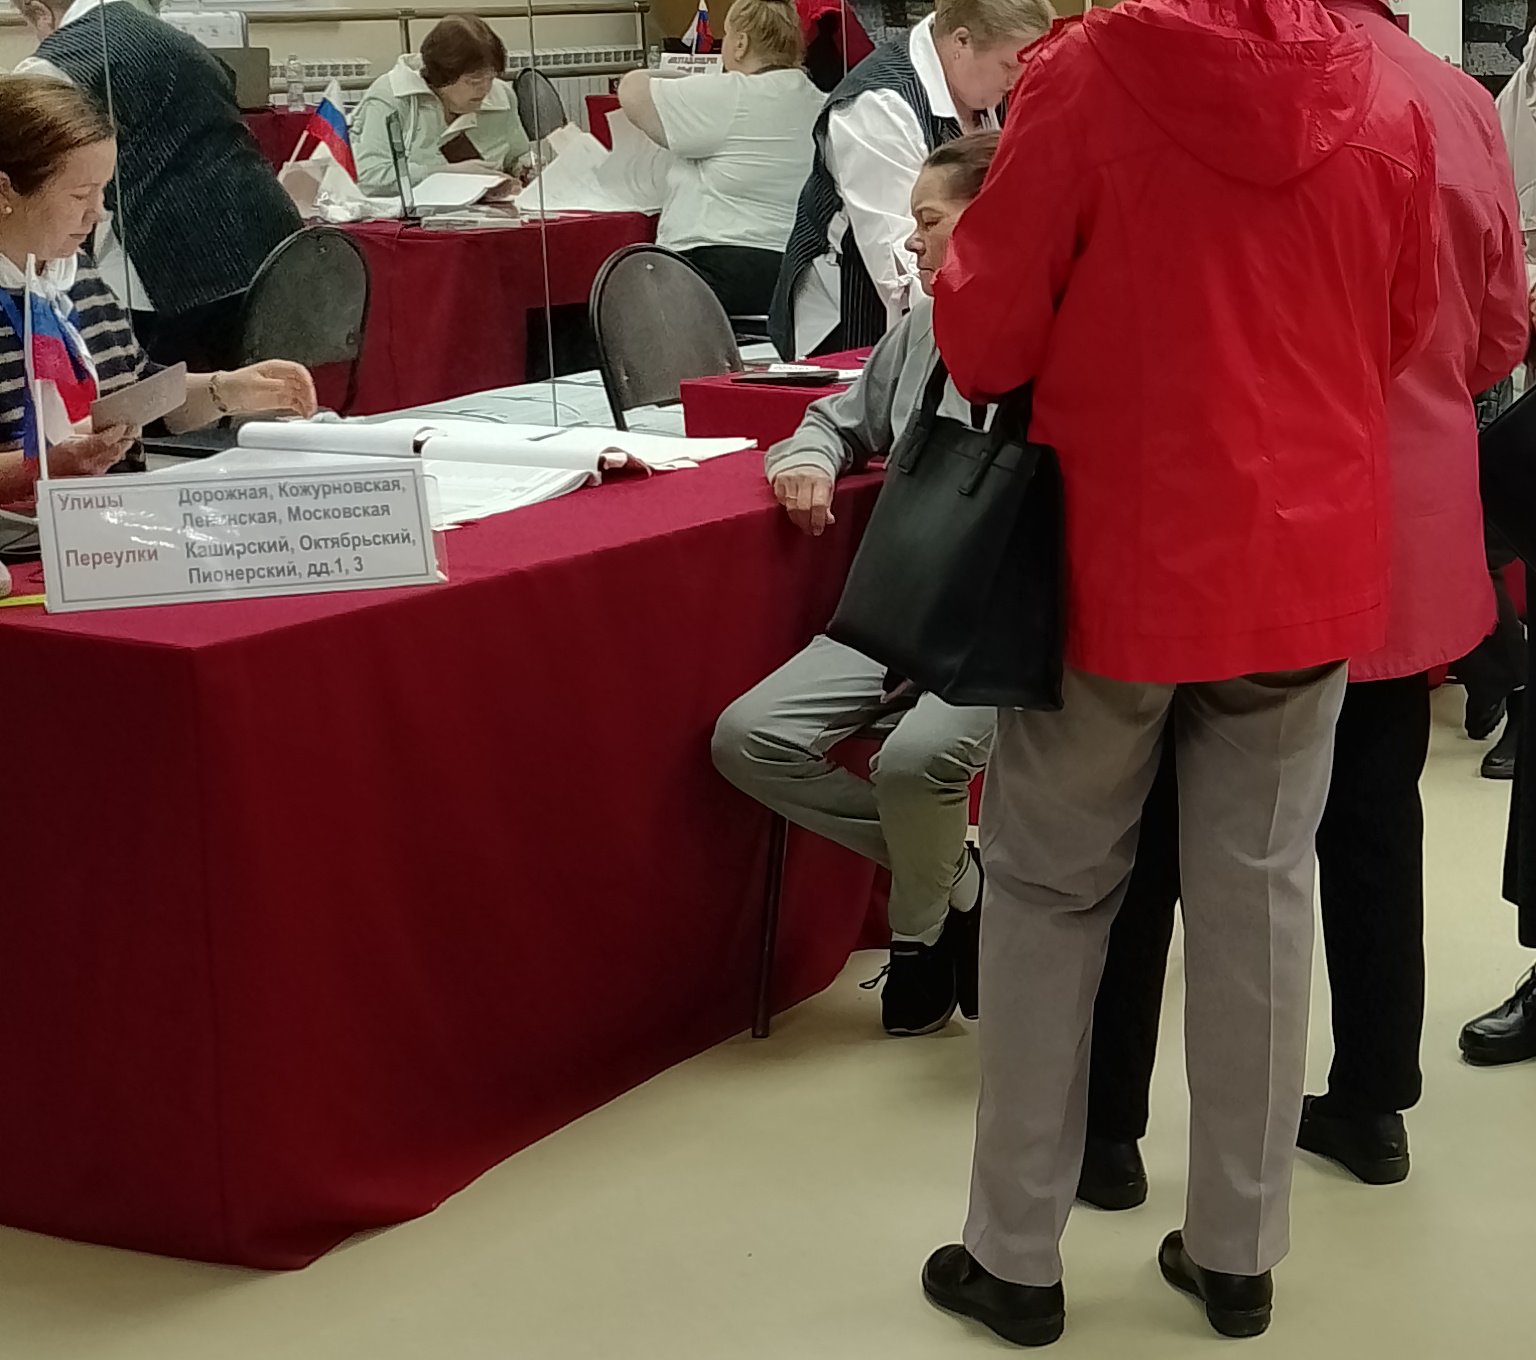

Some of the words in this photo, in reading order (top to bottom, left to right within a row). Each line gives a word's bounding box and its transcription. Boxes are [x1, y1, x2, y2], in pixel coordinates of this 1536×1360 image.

[57, 493, 123, 511] Улицы
[178, 484, 274, 508] Дорожная,
[278, 476, 406, 500] Кожурновская,
[287, 503, 391, 523] Московская
[65, 549, 159, 569] Переулки
[185, 536, 295, 560] Каширский,
[299, 528, 416, 552] Октябрьский,
[188, 561, 302, 584] Пионерский,
[353, 555, 364, 573] 3
